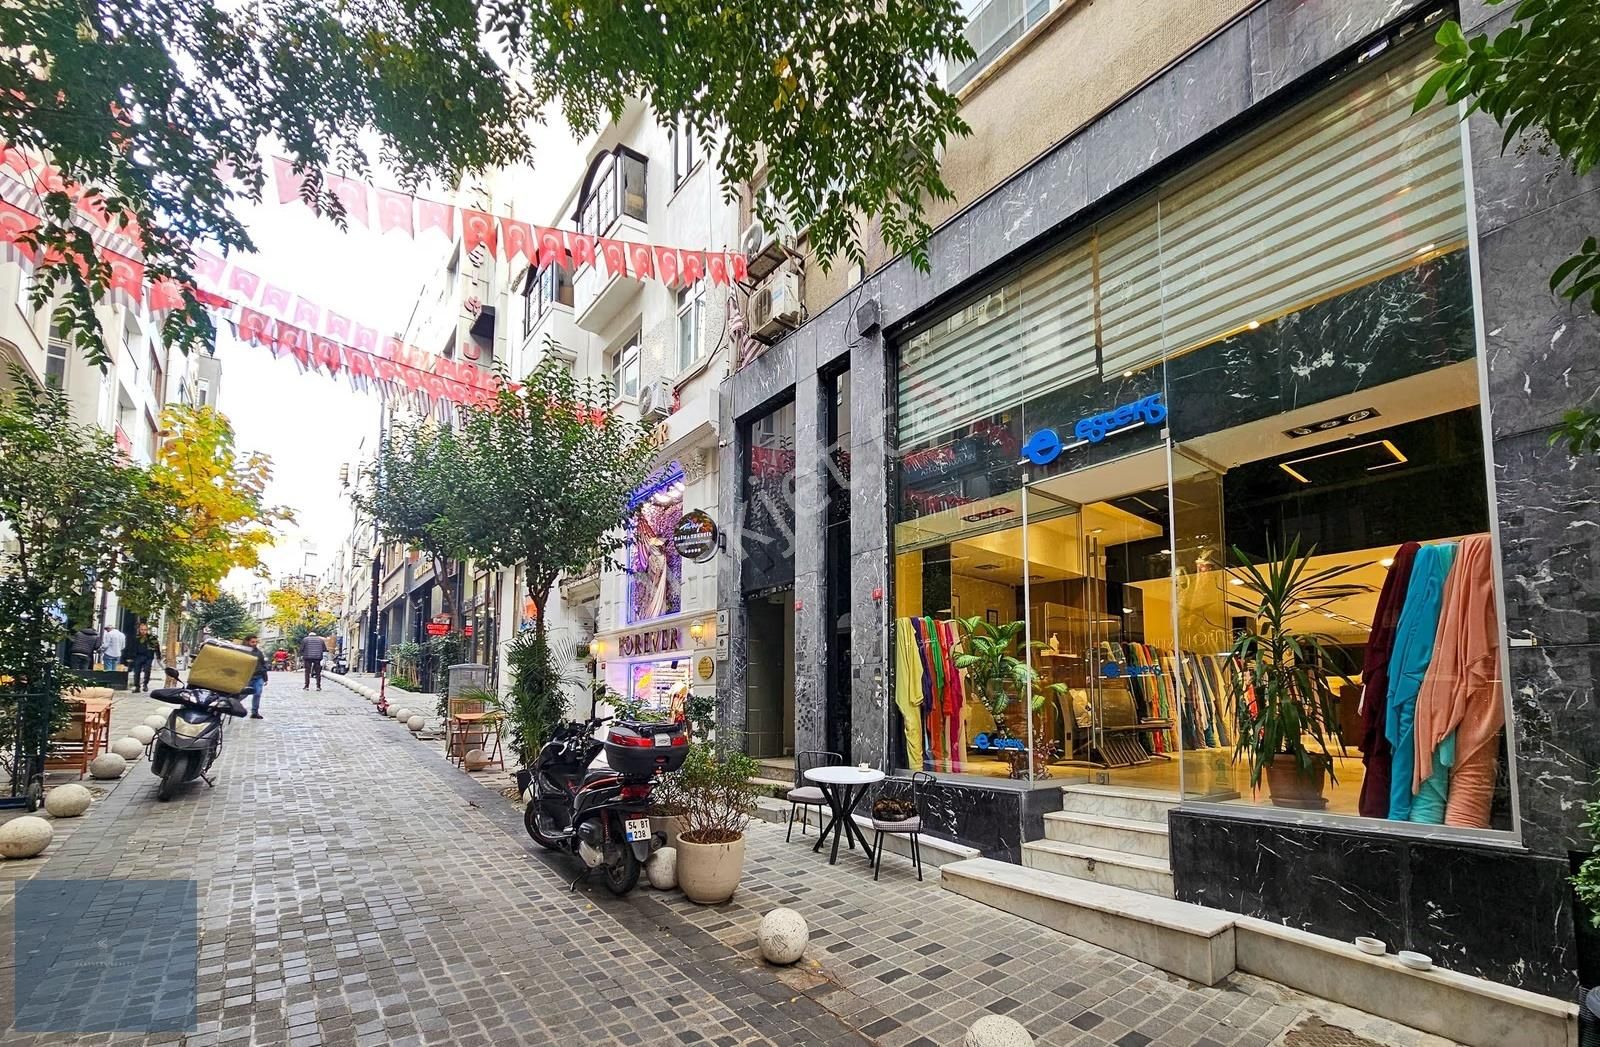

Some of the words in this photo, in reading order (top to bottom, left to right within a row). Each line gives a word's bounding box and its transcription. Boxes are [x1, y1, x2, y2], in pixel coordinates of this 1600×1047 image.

[618, 627, 679, 658] FOREVER
[628, 821, 637, 830] 54
[640, 820, 648, 829] BT
[633, 829, 646, 839] 238
